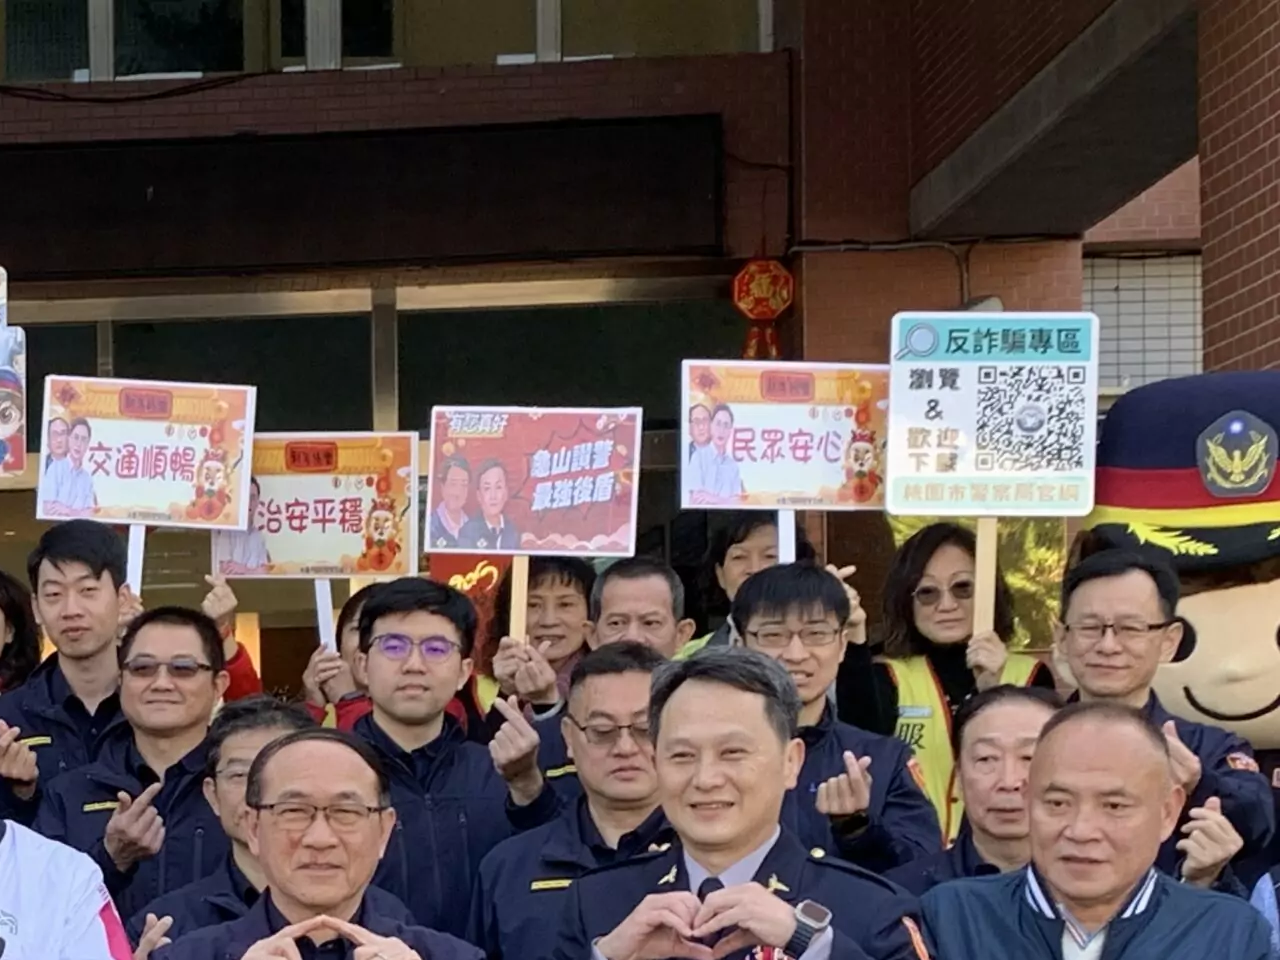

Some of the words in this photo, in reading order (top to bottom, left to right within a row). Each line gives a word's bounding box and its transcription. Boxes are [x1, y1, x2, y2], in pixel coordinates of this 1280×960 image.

[944, 327, 1082, 354] 反詐騙專區
[908, 367, 961, 390] 瀏覽
[924, 399, 943, 420] &
[732, 427, 842, 463] 民眾安心
[907, 427, 960, 450] 歡迎
[88, 441, 196, 481] 交通順暢
[909, 453, 959, 472] 下載
[531, 471, 615, 511] 最強後盾
[257, 497, 365, 535] 治安平穩
